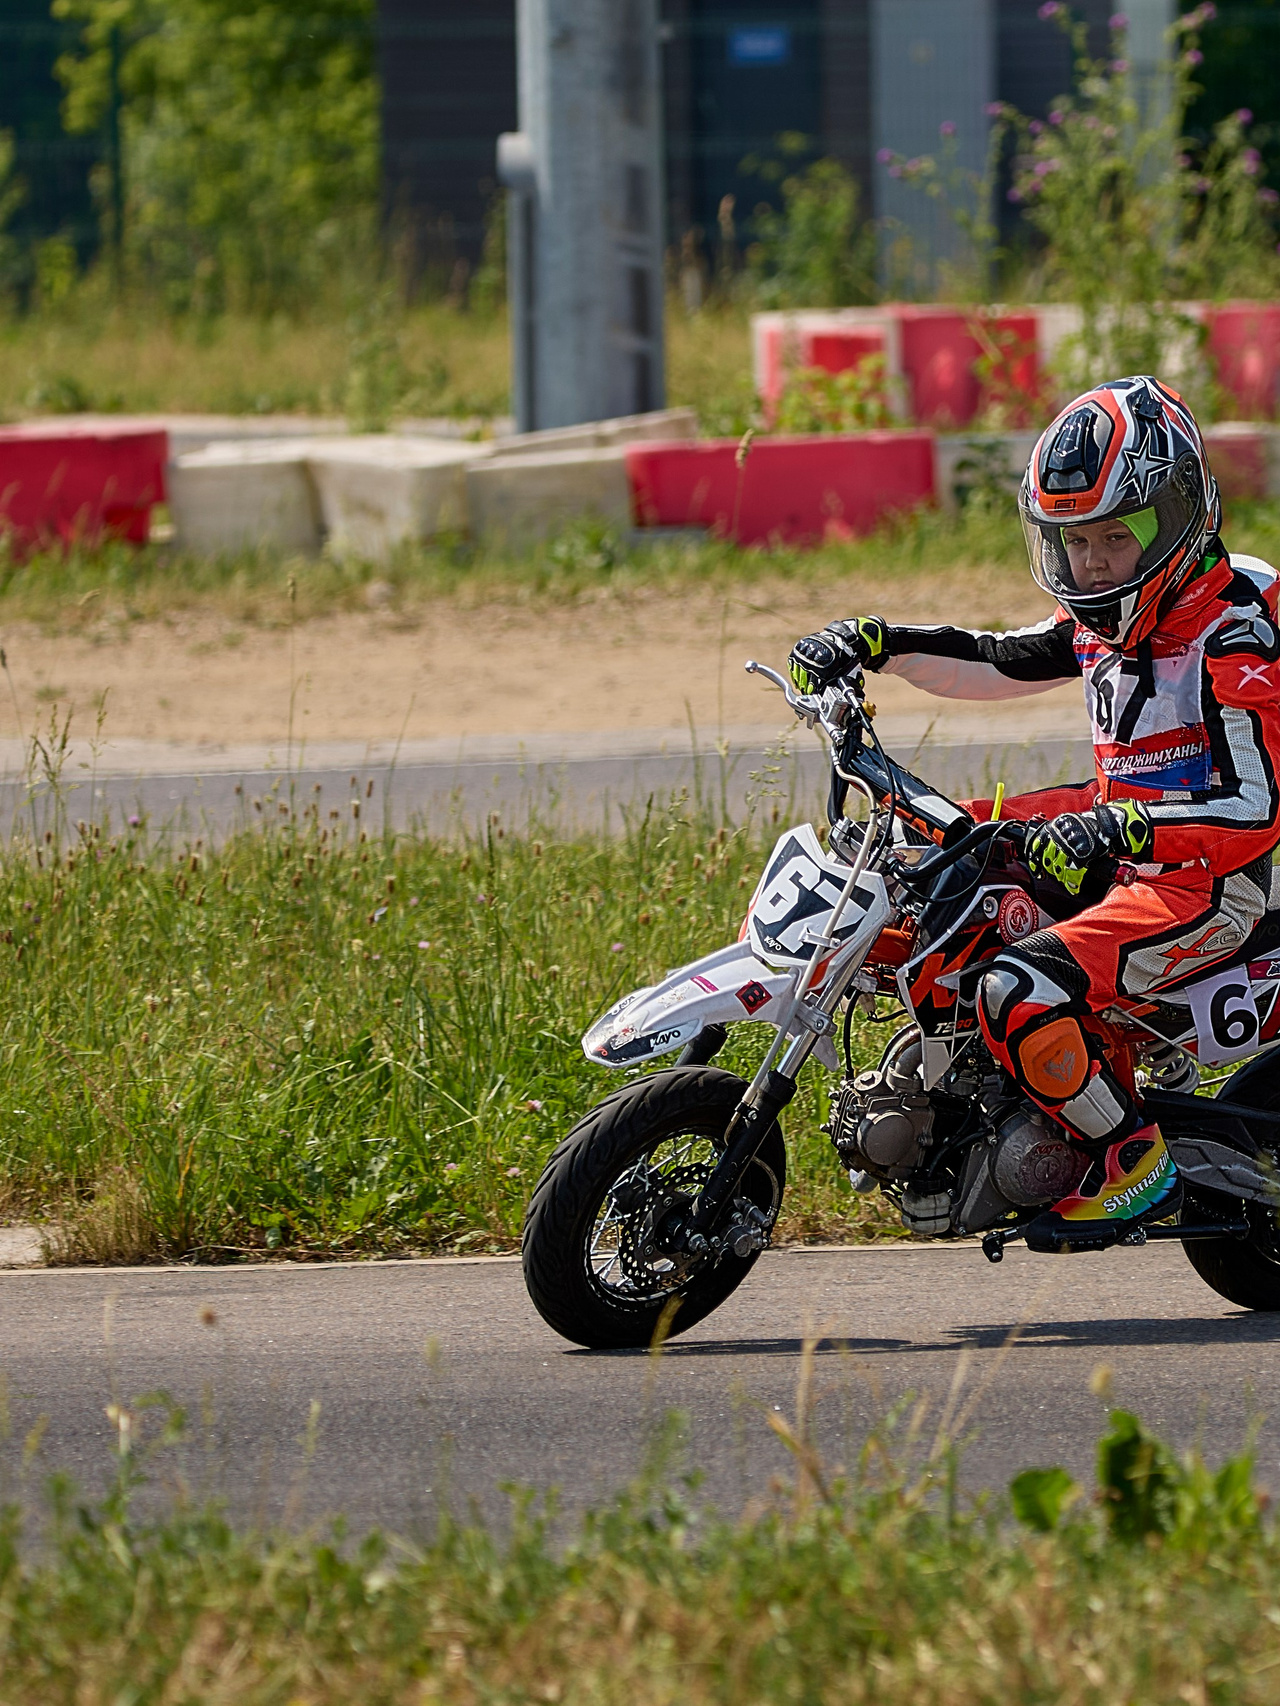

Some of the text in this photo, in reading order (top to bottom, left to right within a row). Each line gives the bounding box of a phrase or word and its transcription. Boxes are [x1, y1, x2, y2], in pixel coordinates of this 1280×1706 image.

[1090, 651, 1153, 747] 67
[754, 854, 869, 954] 67
[934, 1018, 974, 1034] TS90
